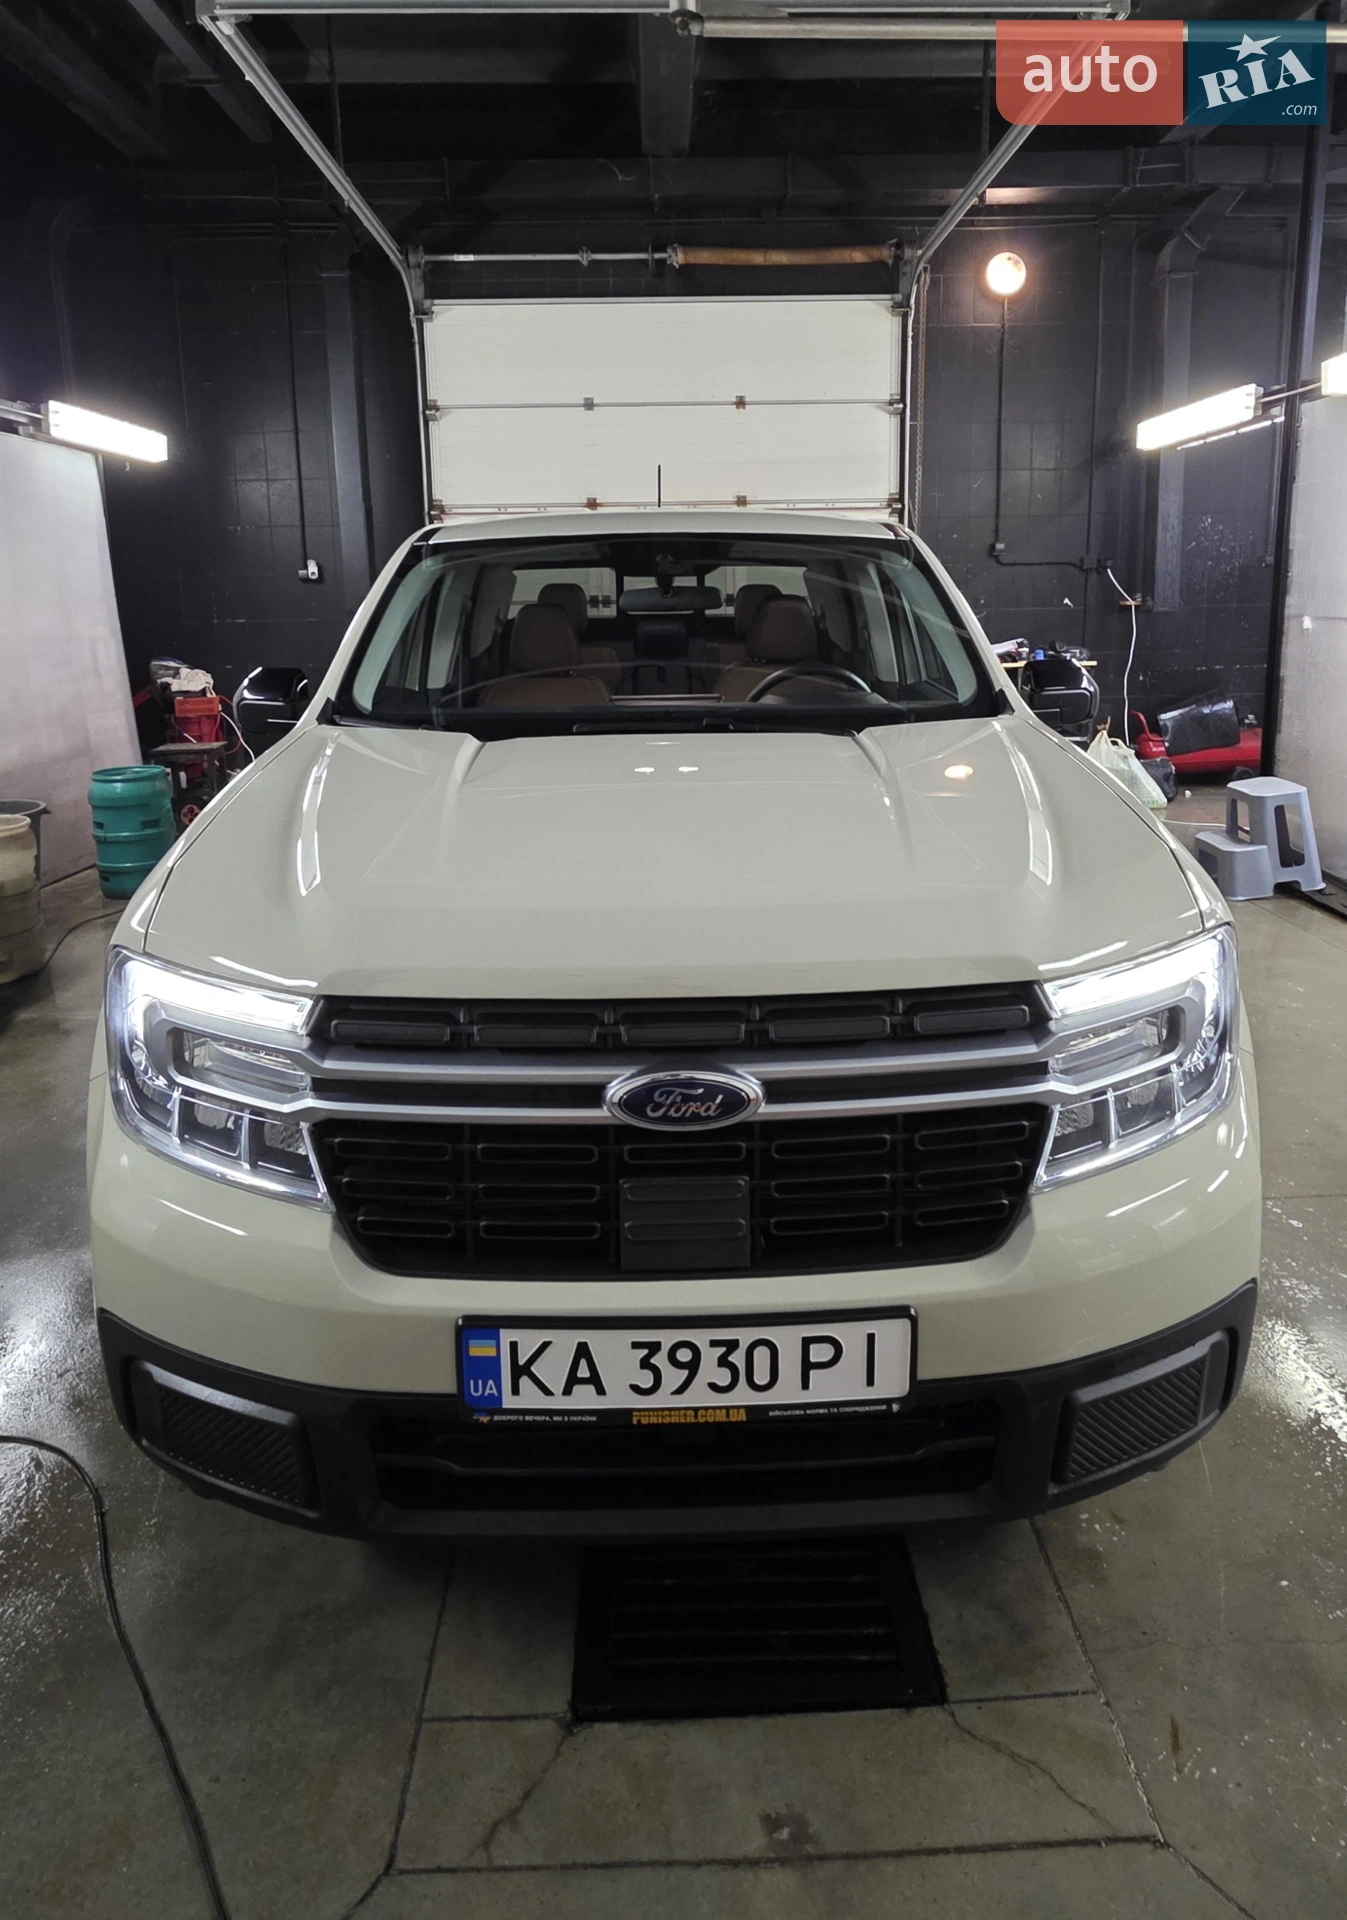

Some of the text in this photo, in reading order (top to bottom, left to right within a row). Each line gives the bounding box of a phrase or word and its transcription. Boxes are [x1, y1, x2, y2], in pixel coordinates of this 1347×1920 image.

[646, 1087, 724, 1118] Ford
[508, 1339, 608, 1397] KA
[628, 1338, 780, 1396] 3930
[469, 1378, 499, 1397] UA
[632, 1408, 747, 1425] PUNISHER.COM.UA
